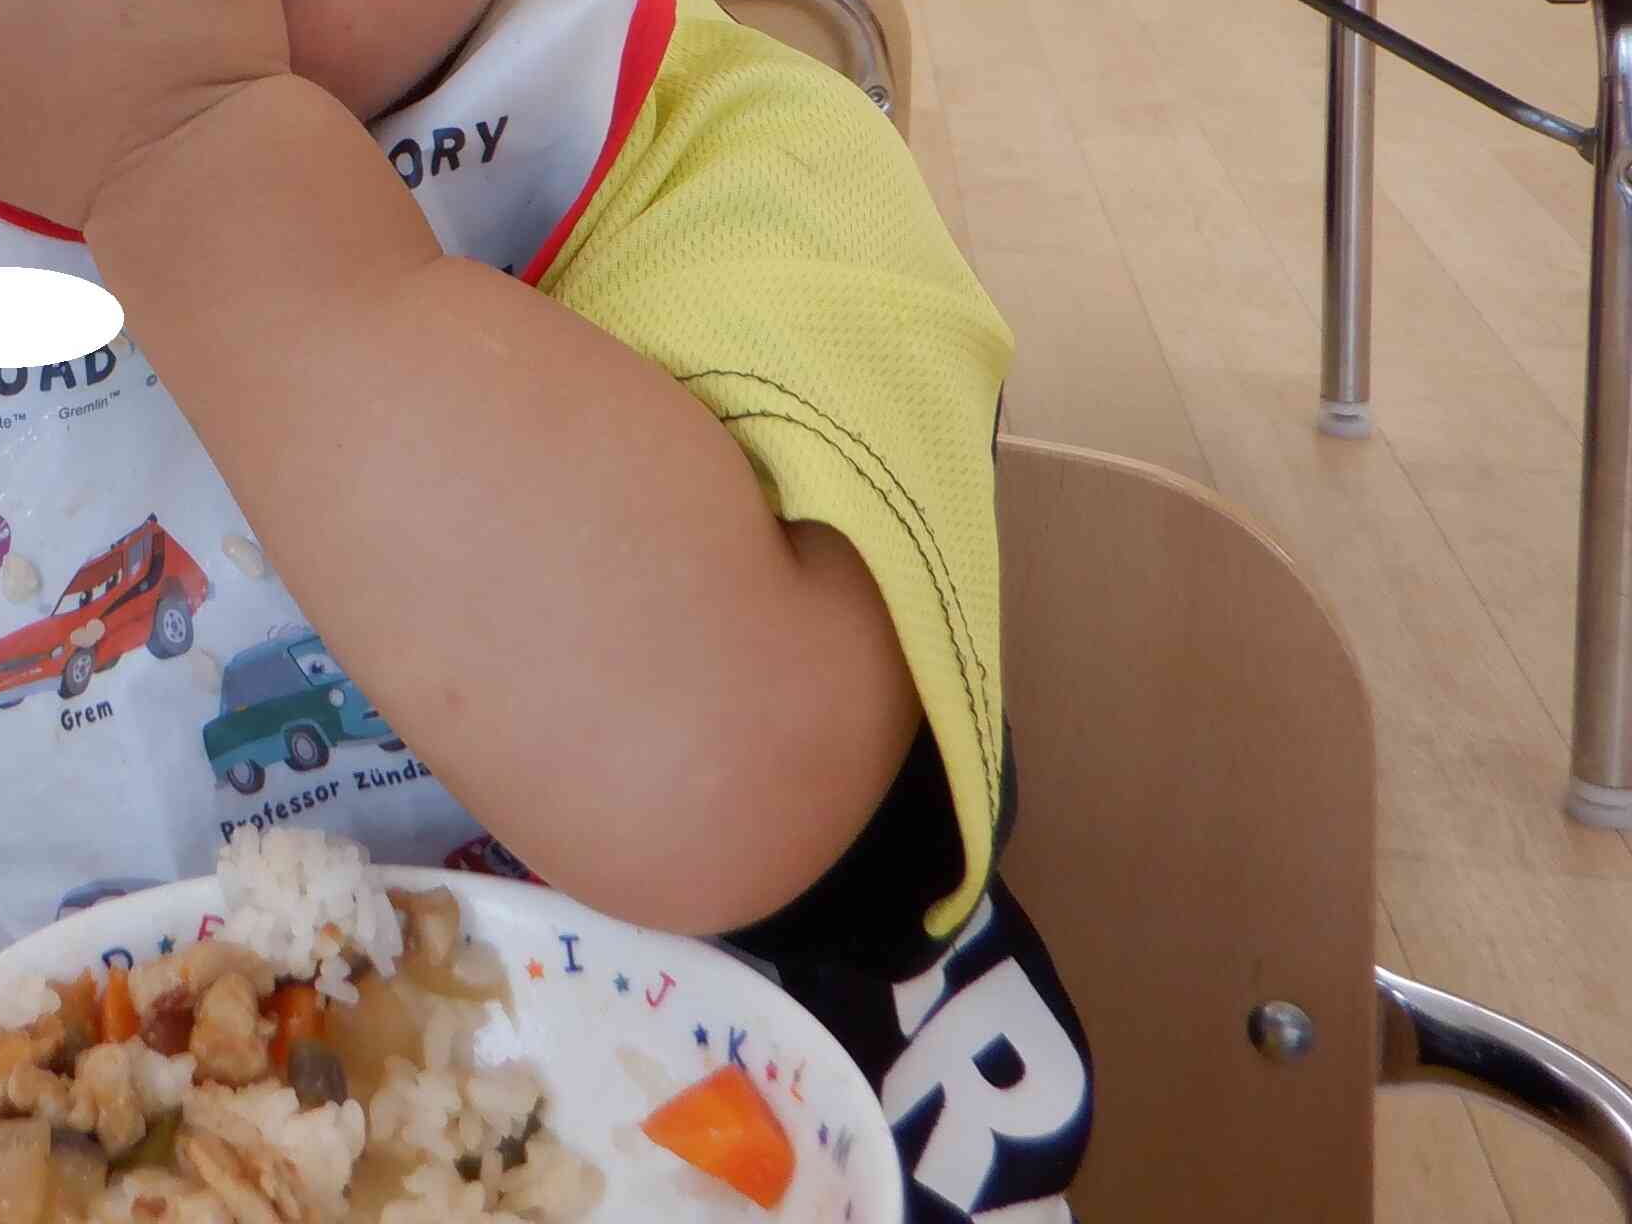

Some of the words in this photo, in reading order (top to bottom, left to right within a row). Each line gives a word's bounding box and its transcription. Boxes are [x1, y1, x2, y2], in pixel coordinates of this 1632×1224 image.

[60, 700, 113, 731] Grem
[559, 934, 584, 973] I
[645, 970, 677, 1008] J
[728, 1026, 747, 1072] K
